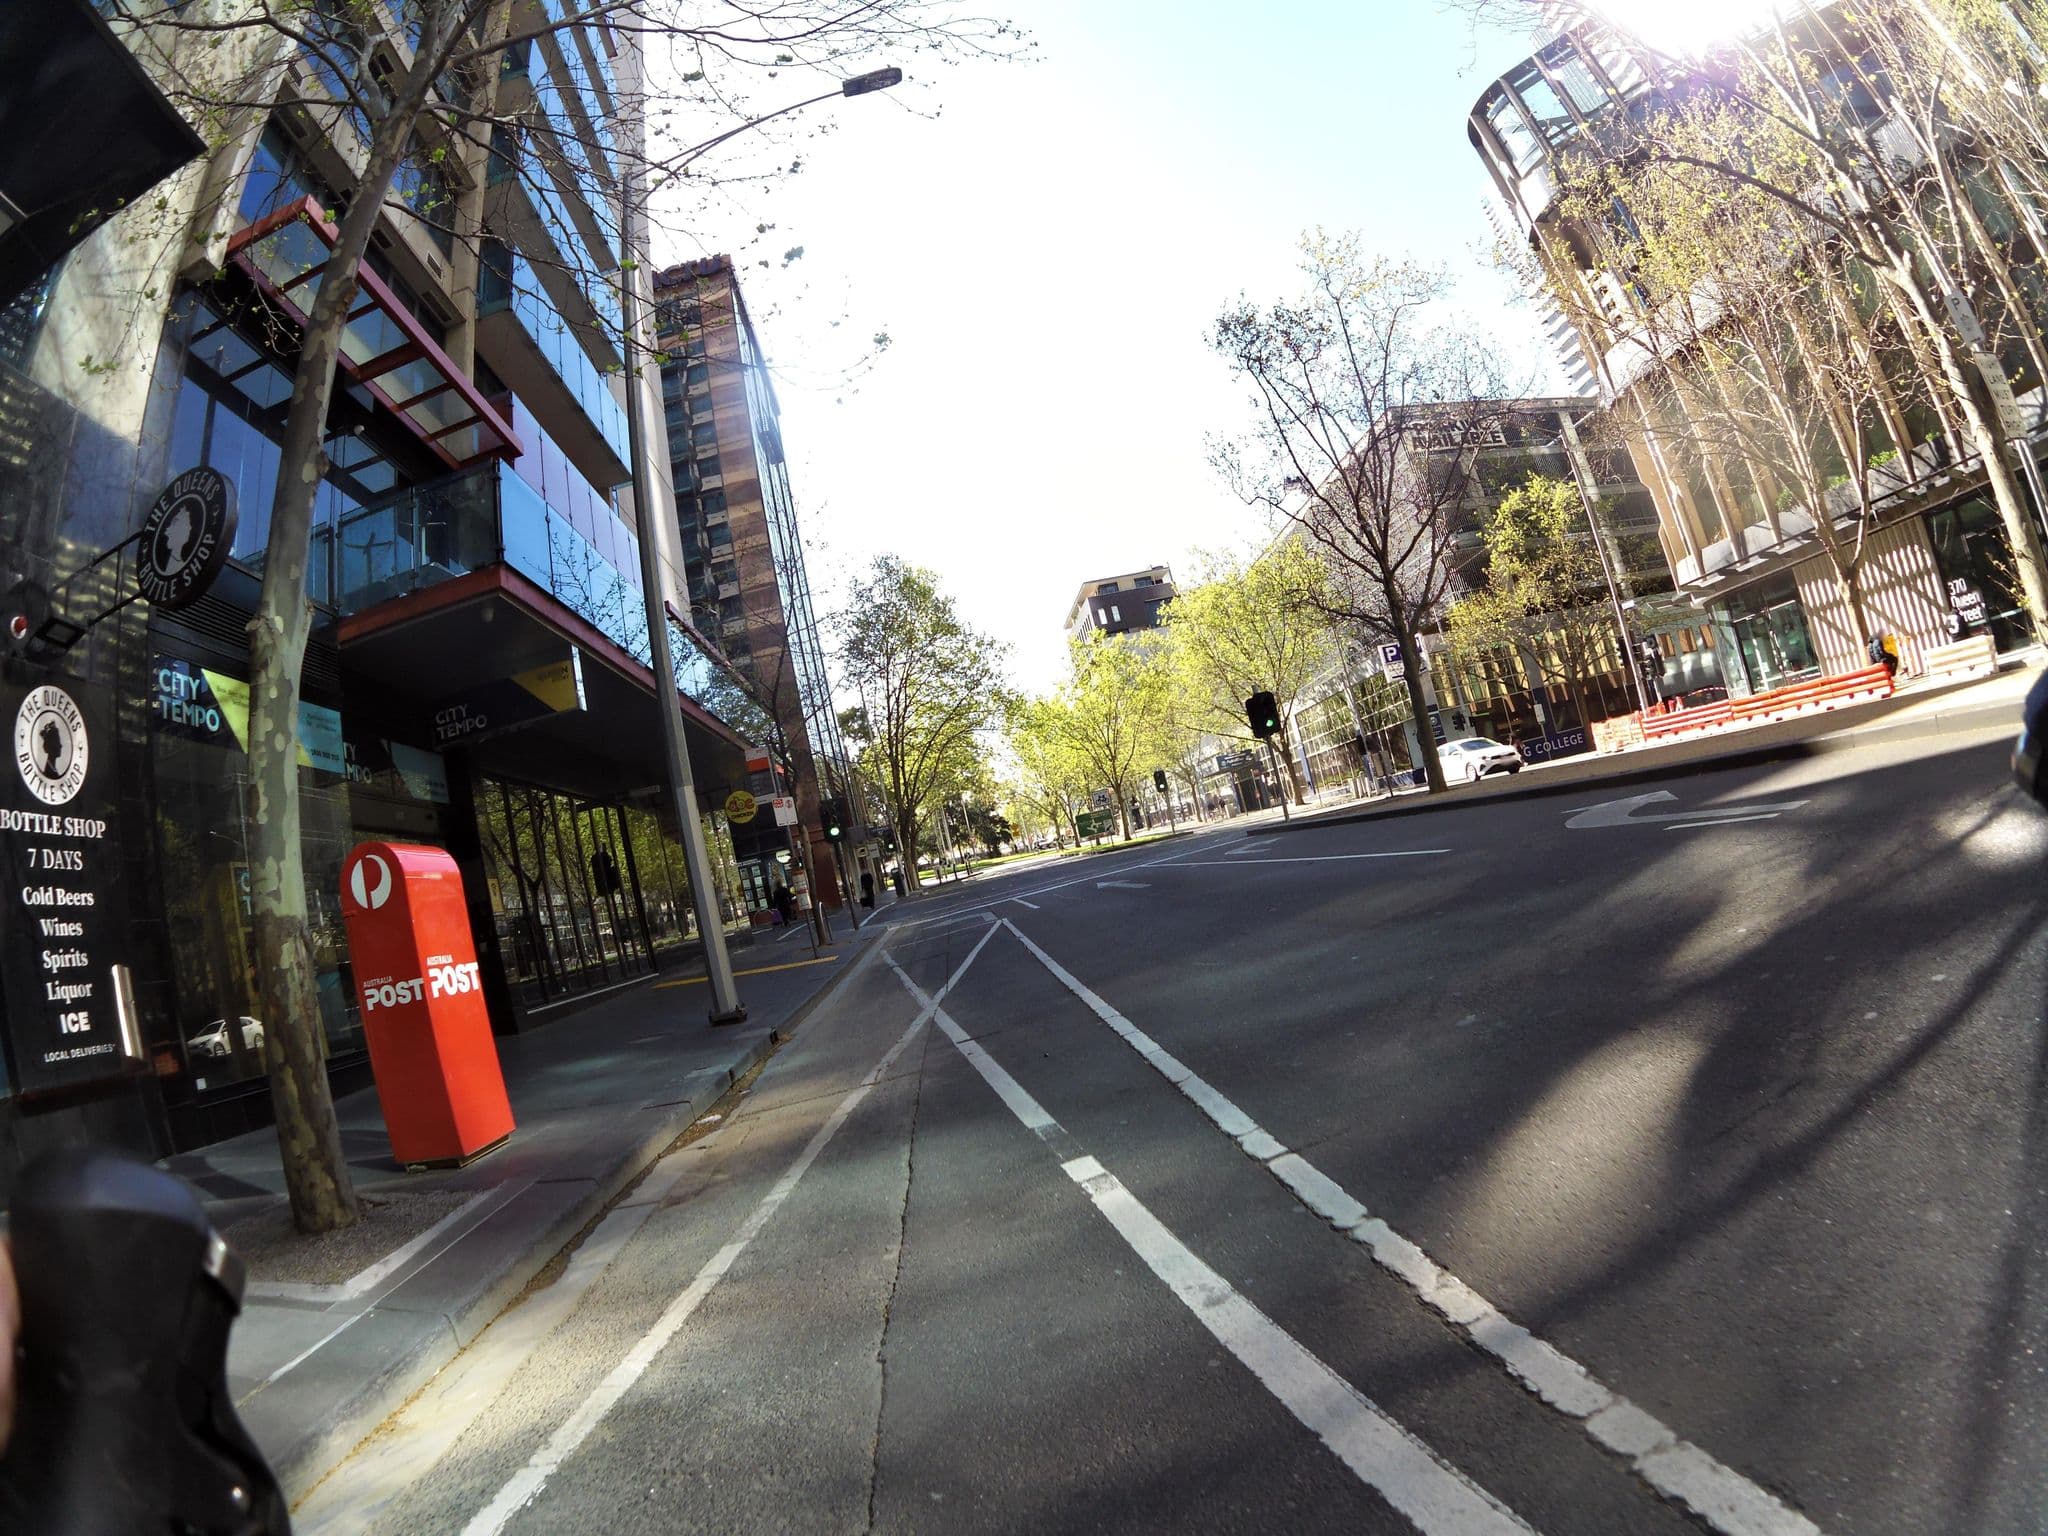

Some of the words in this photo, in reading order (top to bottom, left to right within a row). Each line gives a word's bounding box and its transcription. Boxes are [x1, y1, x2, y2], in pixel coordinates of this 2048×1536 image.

[144, 495, 171, 532] THE
[174, 471, 220, 502] QUEENS
[139, 562, 177, 602] BOTTLE
[182, 533, 215, 588] SHOP
[1947, 577, 1967, 596] 370
[1386, 647, 1397, 661] P
[158, 667, 200, 700] CITY
[20, 694, 41, 724] THE
[43, 689, 82, 733] QUEENS
[159, 694, 220, 732] TEMPO
[435, 703, 469, 725] CITY
[436, 714, 488, 740] TEMPO
[1535, 733, 1584, 754] COLLEGE
[19, 752, 56, 802] BOTTLE
[60, 763, 83, 800] SHOP
[0, 809, 62, 835] BOTTLE
[64, 817, 106, 838] SHOP
[27, 848, 37, 868] 7
[42, 848, 83, 870] DAYS
[22, 886, 54, 905] Cold
[56, 888, 94, 906] Beers
[40, 917, 83, 937] Wines
[42, 948, 88, 973] Spirits
[426, 954, 453, 966] AUSTRALIA
[46, 980, 93, 1004] Liquor
[363, 976, 393, 988] AUSTRALIA
[428, 962, 479, 998] POST
[364, 978, 424, 1010] POST
[60, 1011, 91, 1034] ICE
[44, 1052, 70, 1062] LOCAL
